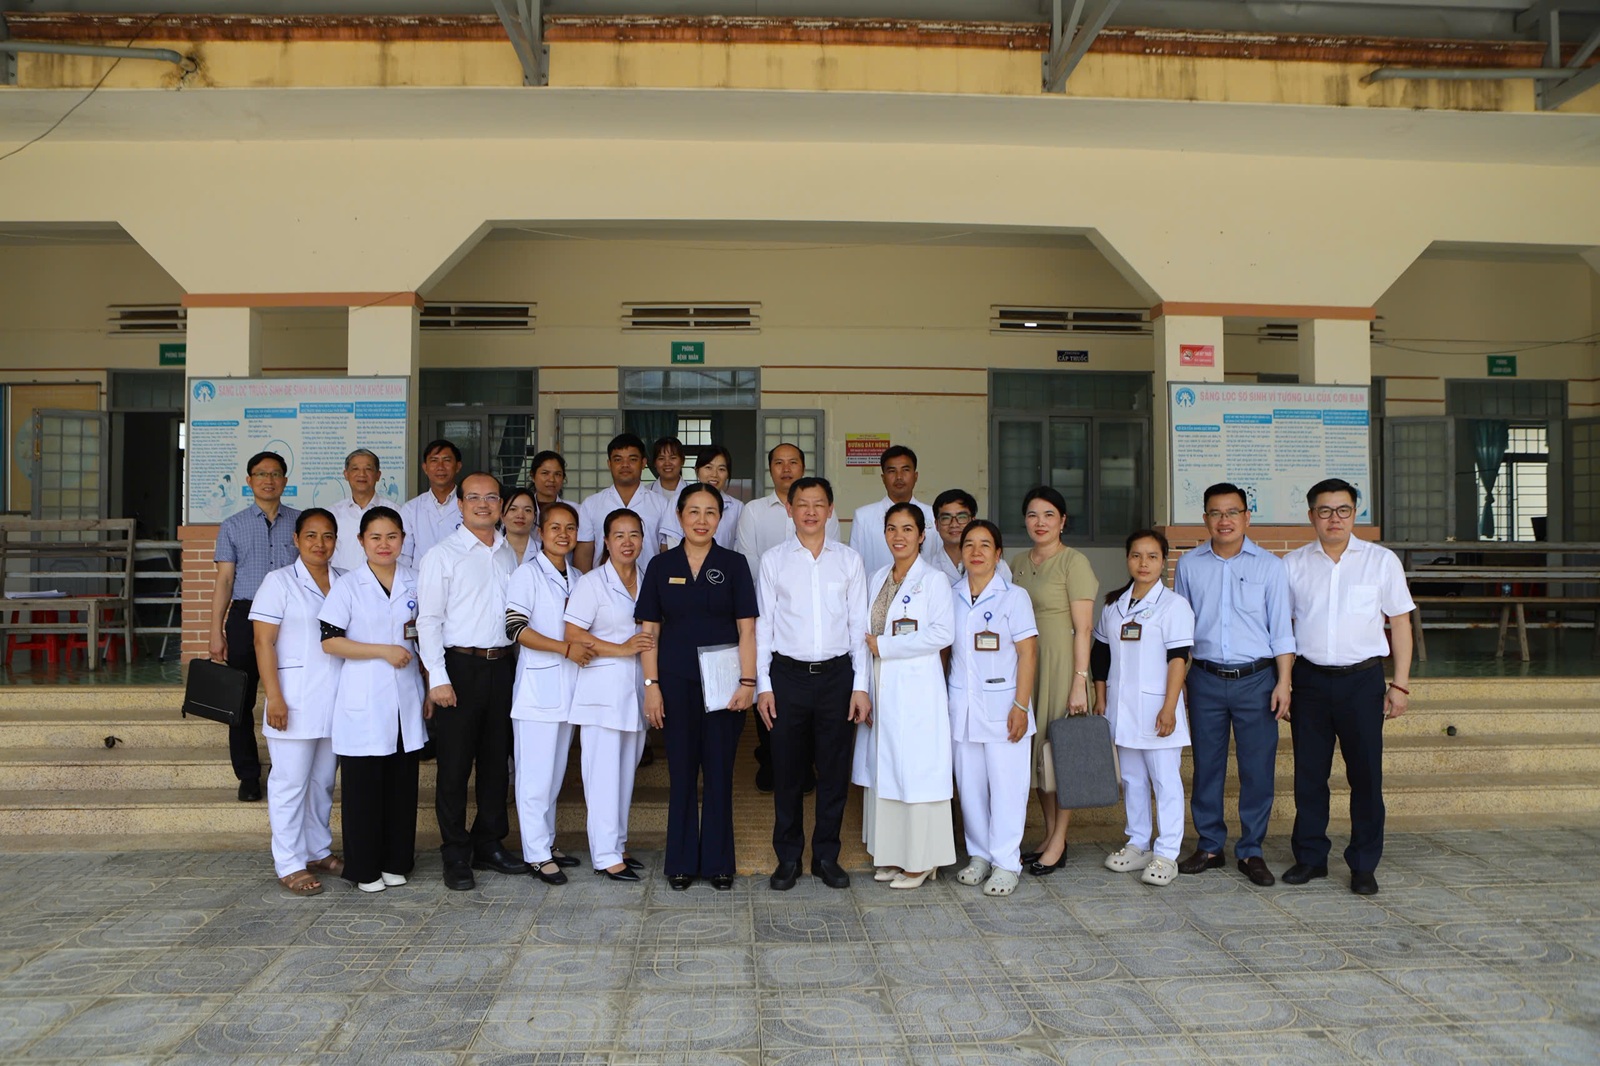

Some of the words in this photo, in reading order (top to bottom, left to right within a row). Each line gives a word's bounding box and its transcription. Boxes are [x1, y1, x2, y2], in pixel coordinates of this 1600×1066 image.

[354, 384, 366, 396] CON
[1249, 391, 1267, 402] SINH
[1304, 392, 1315, 402] LAI
[1333, 393, 1348, 402] CON
[1350, 393, 1364, 405] BẠN
